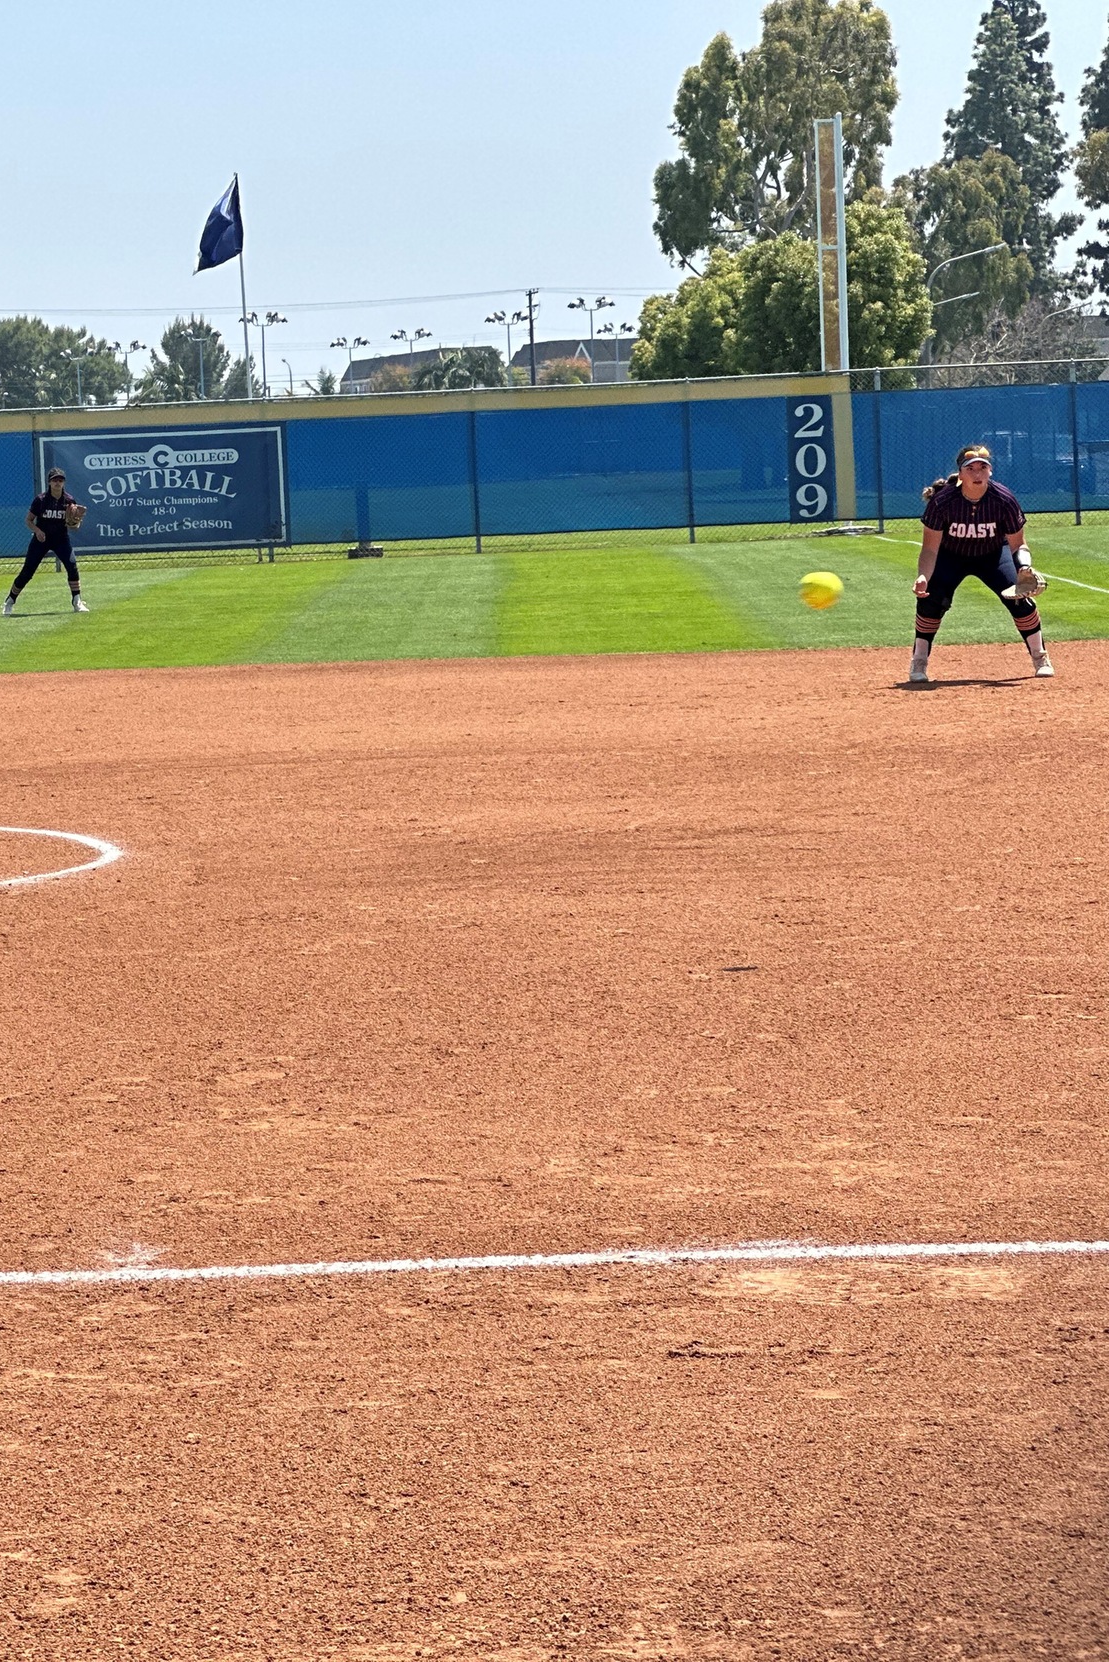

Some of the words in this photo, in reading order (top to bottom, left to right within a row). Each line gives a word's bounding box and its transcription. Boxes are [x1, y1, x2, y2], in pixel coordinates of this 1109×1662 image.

[89, 455, 146, 467] CYPRESS
[176, 452, 234, 464] COLLEGE
[794, 403, 828, 518] 209
[88, 468, 237, 504] SOFTBALL
[109, 498, 134, 508] 2017
[136, 497, 162, 506] State
[164, 495, 218, 506] Champions
[152, 506, 176, 516] 48-0
[96, 524, 124, 537] The
[129, 520, 179, 536] Perfect
[182, 517, 233, 530] Season
[948, 522, 996, 538] COAST
